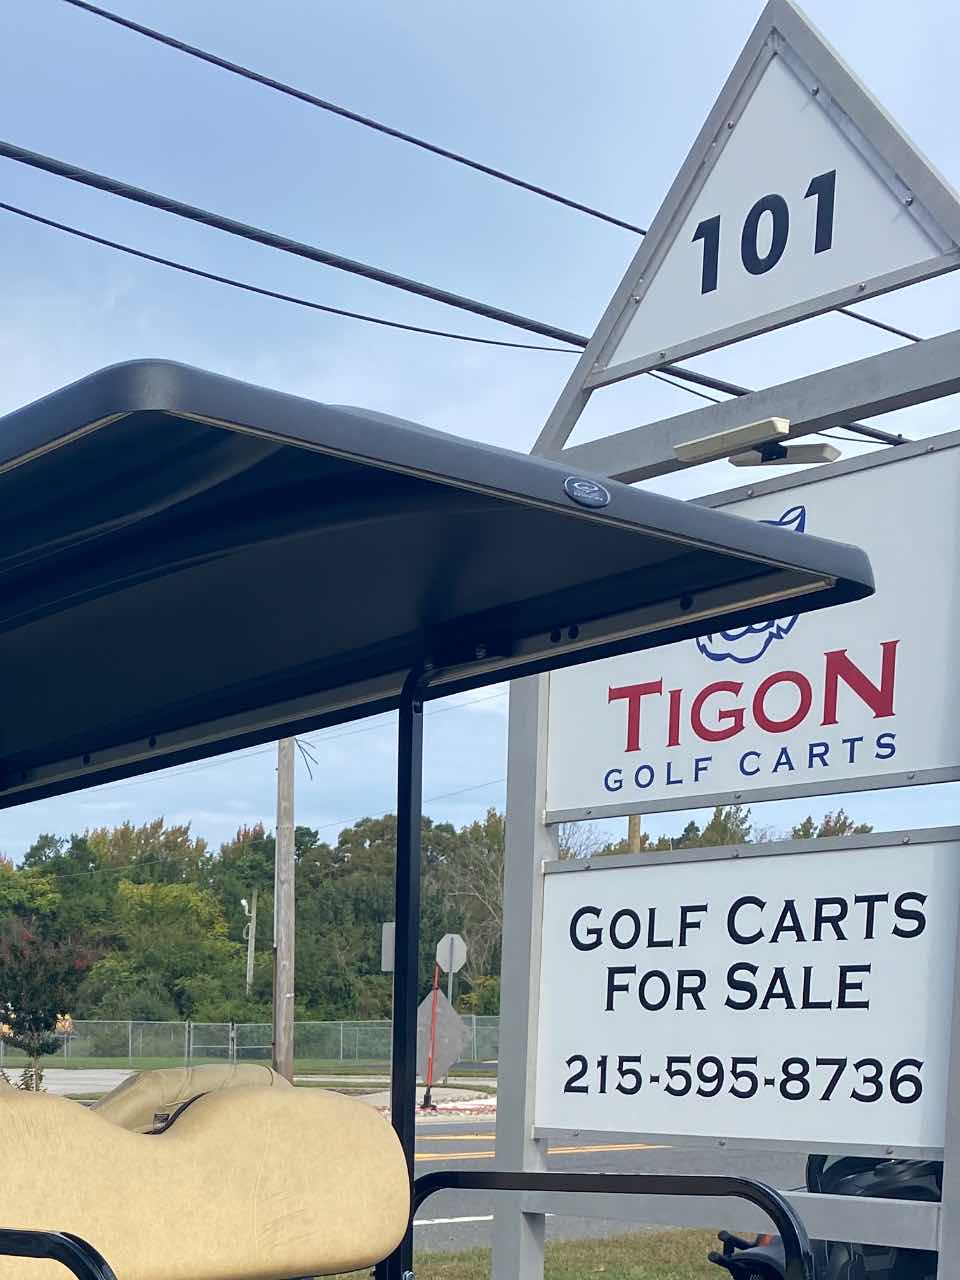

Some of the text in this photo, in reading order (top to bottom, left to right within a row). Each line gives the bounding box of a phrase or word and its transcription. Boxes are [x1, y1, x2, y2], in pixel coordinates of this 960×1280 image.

[691, 169, 837, 296] 101
[608, 640, 900, 753] TIGON
[604, 732, 897, 792] GOLF CARTS
[569, 891, 928, 952] GOLF CARTS
[605, 961, 872, 1012] FOR SALE
[563, 1054, 925, 1105] 215-595-8736
